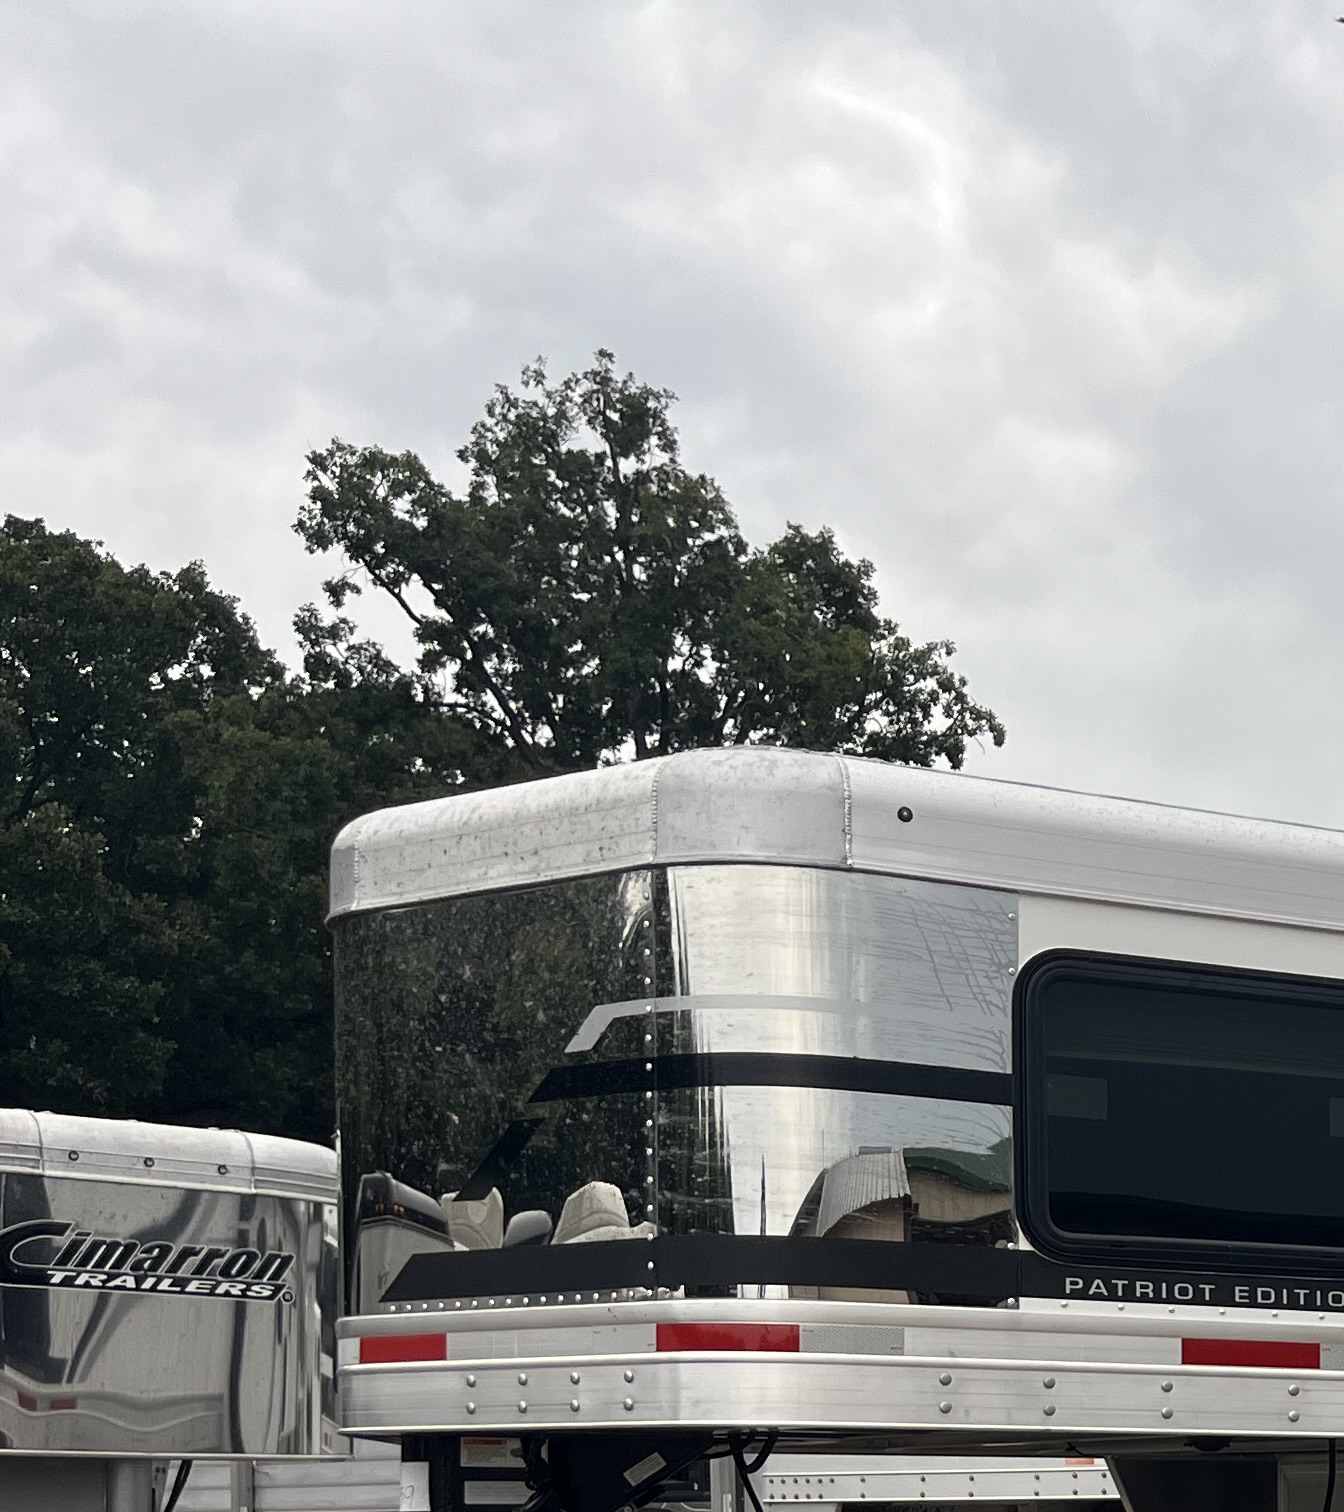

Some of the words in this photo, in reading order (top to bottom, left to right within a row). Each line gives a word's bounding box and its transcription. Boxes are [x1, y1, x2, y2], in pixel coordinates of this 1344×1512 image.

[0, 1219, 295, 1288] Cimarron
[47, 1270, 281, 1298] TRAILERS
[1064, 1277, 1216, 1301] PATRIOT
